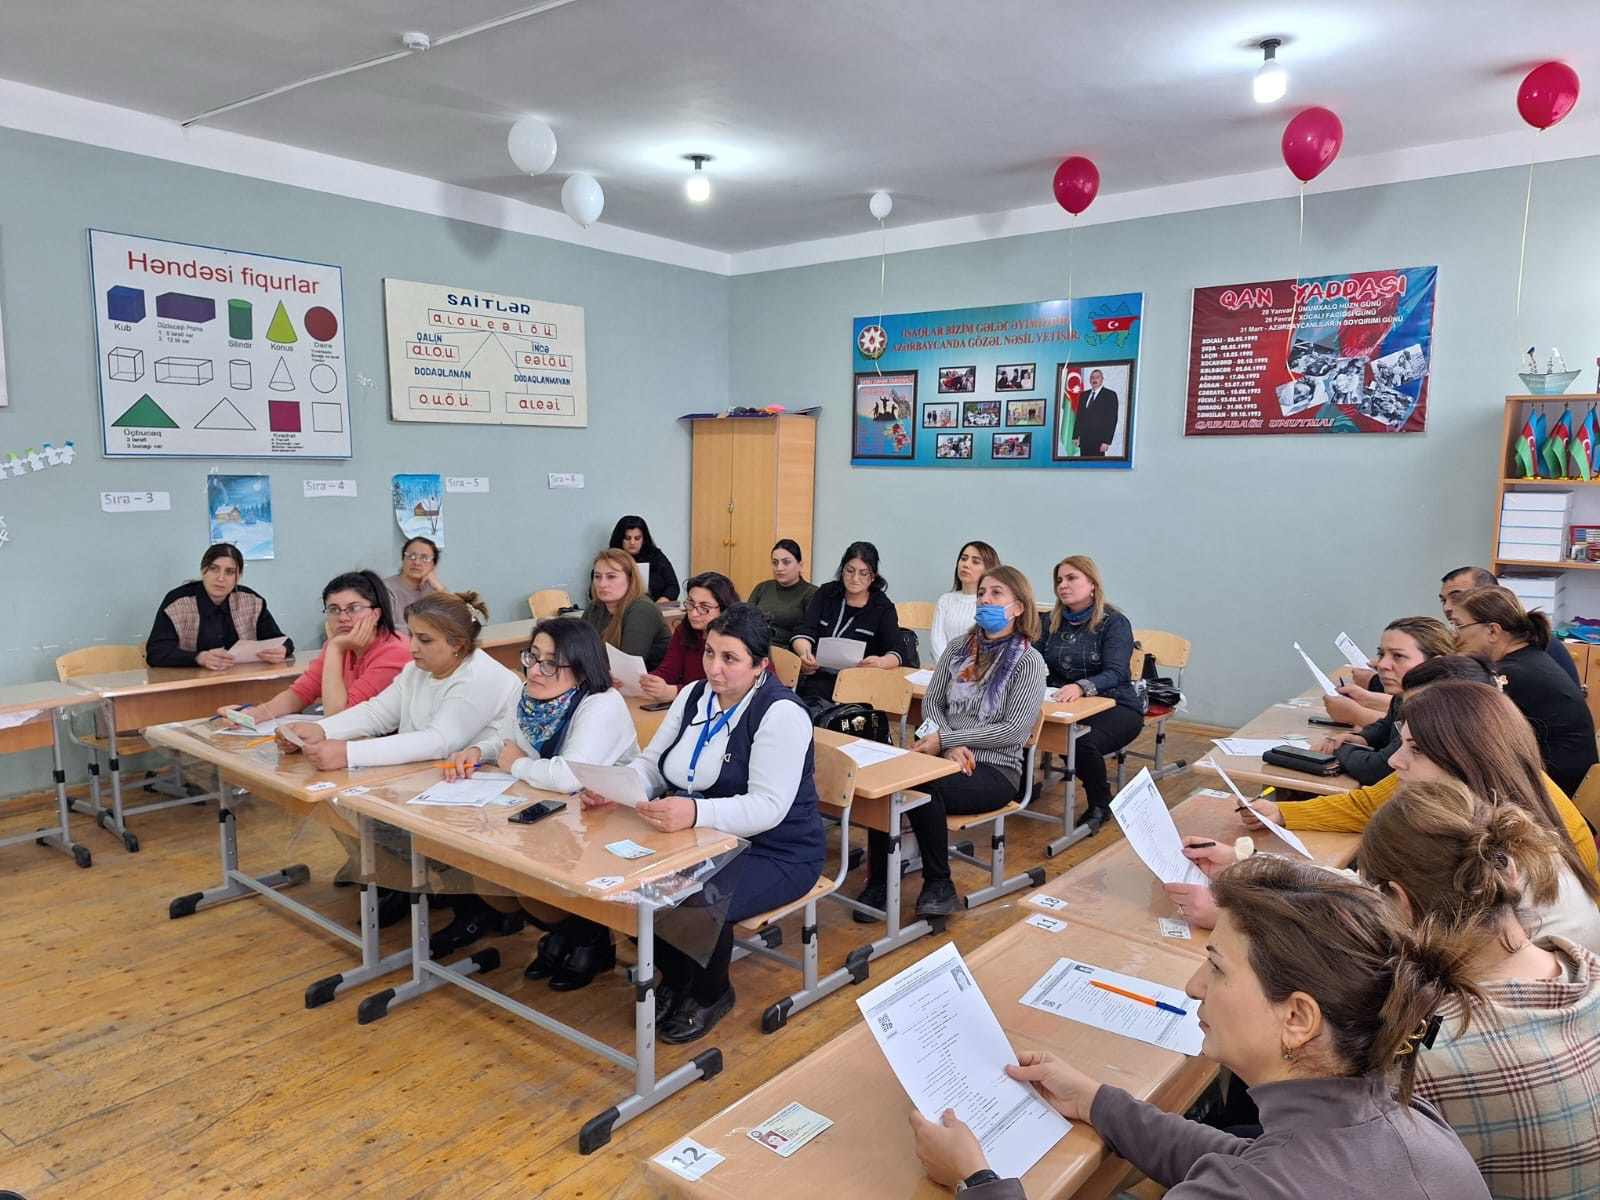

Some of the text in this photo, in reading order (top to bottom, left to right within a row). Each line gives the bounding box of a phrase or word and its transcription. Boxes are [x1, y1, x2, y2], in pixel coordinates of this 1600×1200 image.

[127, 250, 320, 295] Həndəsi fiqurlar
[447, 294, 531, 315] SAİTLƏR
[1220, 287, 1273, 310] QAN
[114, 322, 132, 332] Kub
[270, 342, 294, 352] Konus
[414, 366, 472, 379] DODAQLANAN
[123, 429, 162, 438] Üçbucaq
[305, 480, 327, 491] Sıra
[338, 481, 345, 491] 4
[447, 478, 465, 488] Sıra
[104, 493, 131, 505] Sıra
[146, 492, 154, 504] 3
[671, 1145, 707, 1170] 12
